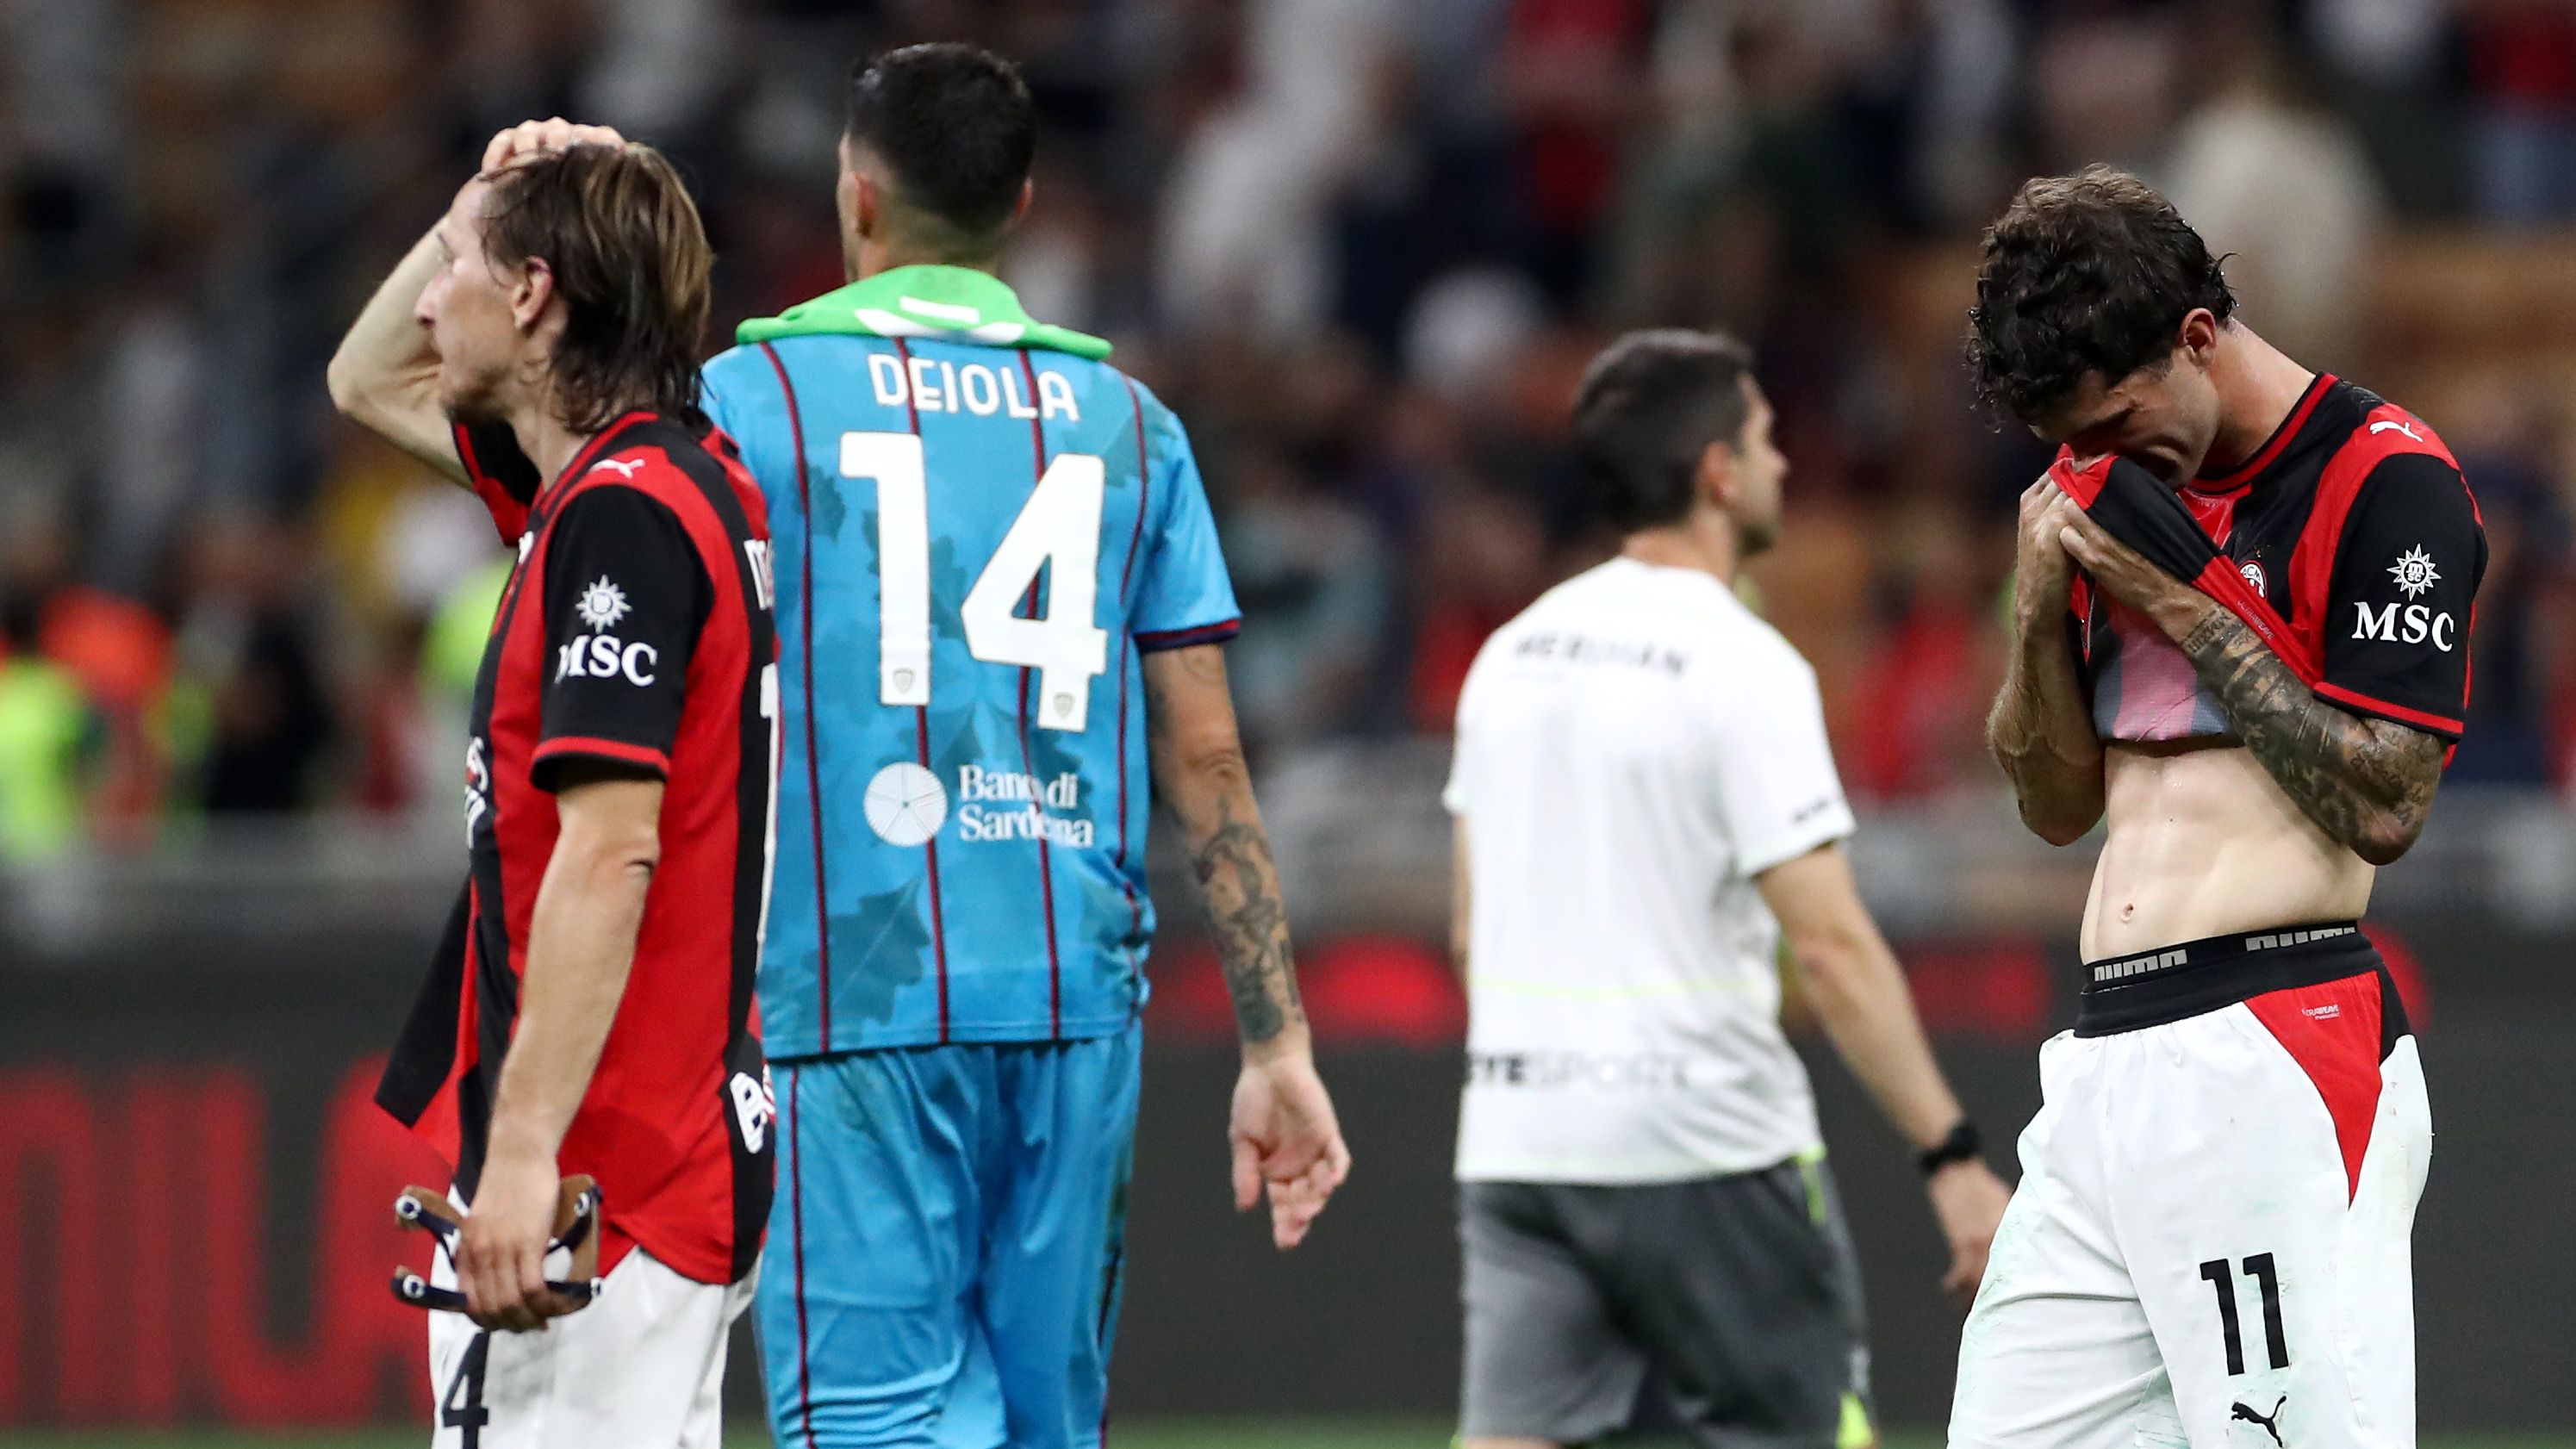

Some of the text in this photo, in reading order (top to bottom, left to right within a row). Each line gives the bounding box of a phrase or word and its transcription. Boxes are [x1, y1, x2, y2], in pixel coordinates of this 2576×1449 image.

[867, 352, 1081, 422] DEIOLA
[838, 431, 1109, 732] 14
[554, 634, 657, 687] MSC
[2351, 601, 2455, 652] MSC
[1046, 772, 1078, 809] di
[2200, 1252, 2289, 1377] 11
[441, 1332, 489, 1449] 4
